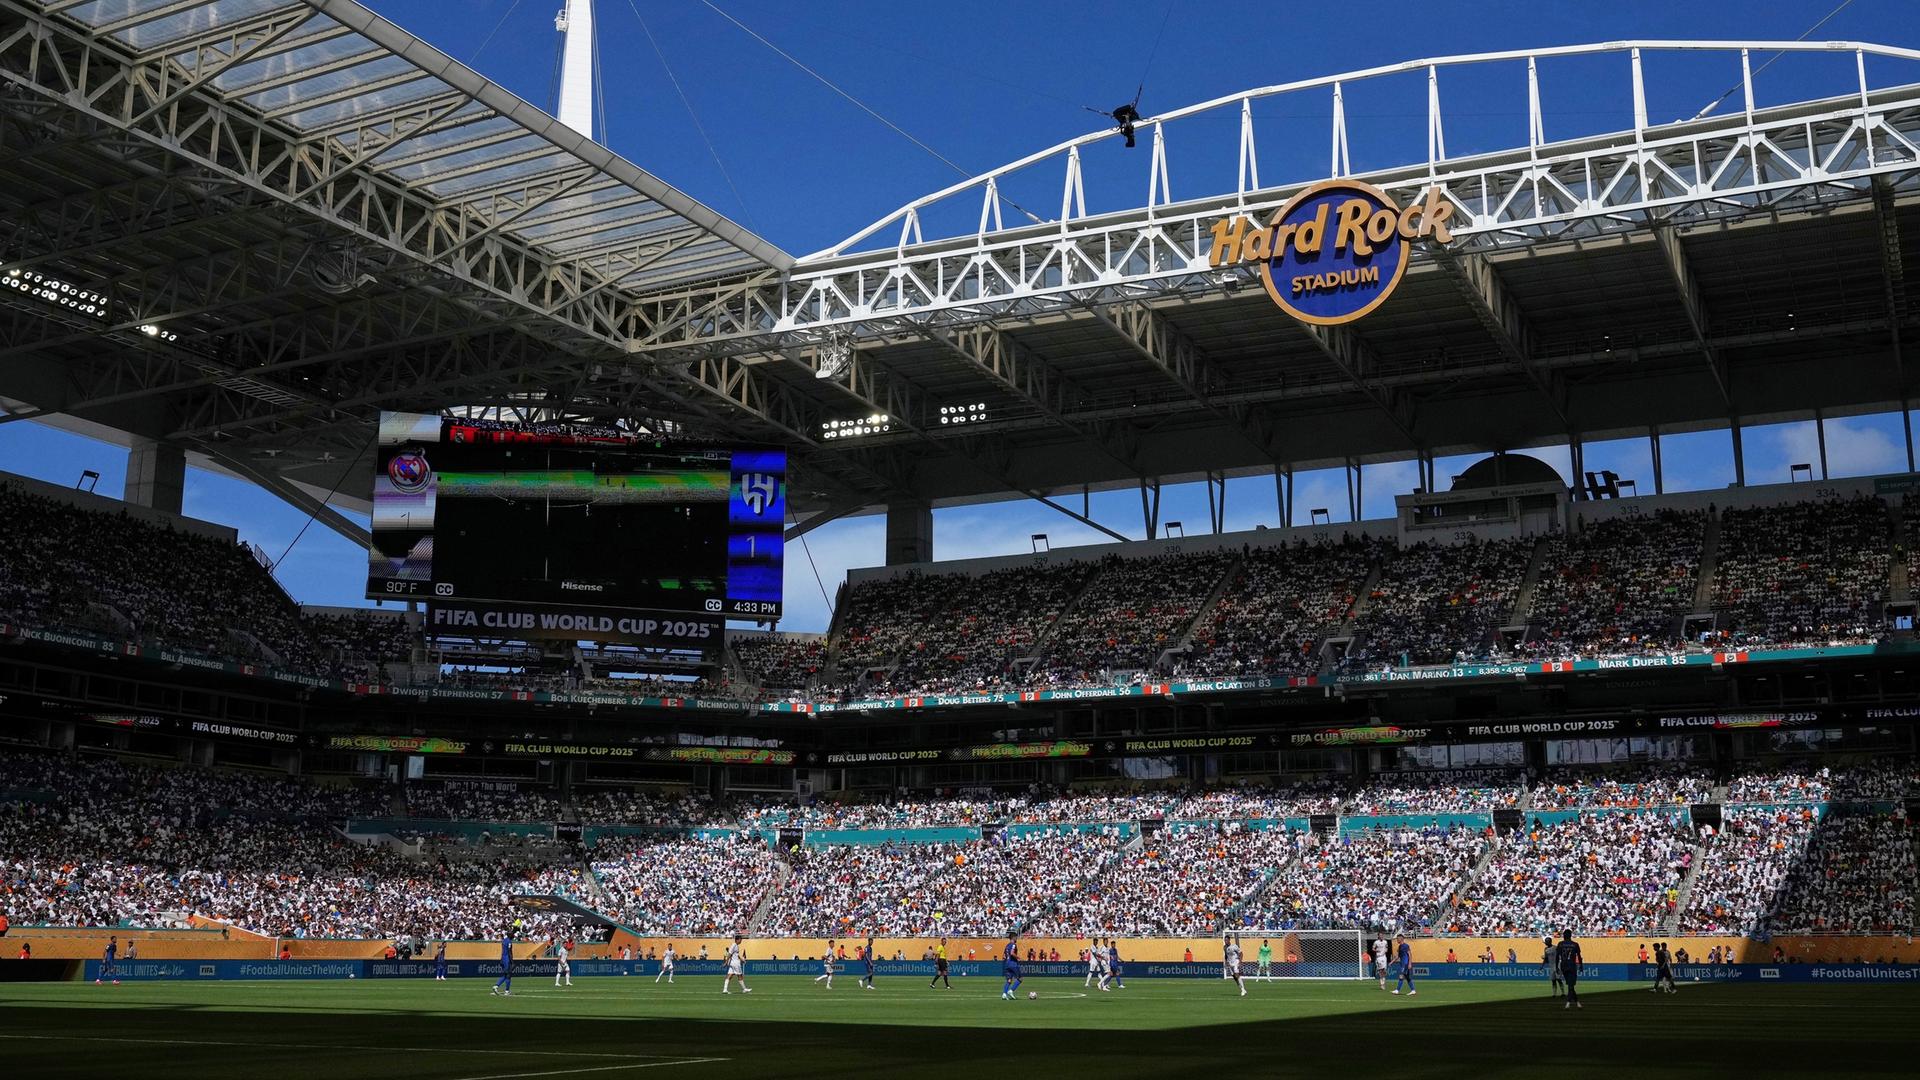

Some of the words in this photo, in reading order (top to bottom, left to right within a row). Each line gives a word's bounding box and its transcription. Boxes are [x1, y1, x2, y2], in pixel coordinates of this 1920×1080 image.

[1209, 203, 1330, 267] Hard
[1334, 186, 1455, 256] Rock
[1292, 266, 1379, 292] STADIUM
[1815, 489, 1835, 498] 334
[1620, 506, 1640, 515] 333
[1313, 532, 1329, 541] 331
[1454, 532, 1473, 541] 332
[746, 535, 757, 559] 1
[410, 582, 417, 594] F
[437, 584, 454, 595] CC
[560, 581, 603, 592] Hisense
[705, 600, 722, 612] CC
[734, 601, 757, 613] 4:33
[760, 602, 776, 614] PM
[434, 609, 478, 626] FIFA
[483, 611, 535, 630] CLUB
[540, 613, 613, 633] WORLD
[617, 617, 657, 635] CUP
[102, 641, 114, 651] 85
[161, 651, 176, 663] BILL
[1598, 659, 1629, 669] MARK
[1632, 657, 1667, 668] DUPER
[1671, 656, 1686, 665] 85
[1390, 671, 1409, 681] DAN
[1412, 670, 1450, 680] MARINO
[1452, 668, 1464, 677] 13
[319, 678, 329, 688] 66
[1187, 682, 1213, 692] MARK
[1215, 680, 1256, 691] CLAYTON
[1258, 679, 1271, 688] 83
[392, 686, 429, 697] DWIGHT
[432, 688, 488, 699] STEPHENSON
[490, 691, 503, 699] 57
[1050, 690, 1072, 699] JOHN
[1074, 689, 1117, 699] OFFERDAHL
[1119, 687, 1131, 696] 56
[551, 694, 569, 703] BOB
[631, 697, 644, 705] 67
[697, 700, 739, 710] RICHMOND
[768, 703, 779, 711] 78
[938, 696, 960, 706] DOUG
[962, 696, 991, 705] BETTERS
[993, 694, 1004, 703] 75
[819, 704, 834, 712] BOB
[884, 700, 896, 708] 73
[1866, 708, 1893, 718] FIFA
[1660, 717, 1685, 727] FIFA
[1687, 716, 1716, 726] CLUB
[1717, 714, 1761, 724] WORLD
[1762, 713, 1785, 722] CUP
[192, 721, 209, 732] FIFA
[210, 724, 230, 735] CLUB
[232, 727, 259, 738] WORLD
[260, 730, 275, 741] CUP
[1469, 726, 1491, 735] FIFA
[1493, 724, 1520, 734] CLUB
[1522, 722, 1562, 732] WORLD
[1563, 721, 1585, 731] CUP
[1291, 734, 1312, 743] FIFA
[1314, 732, 1339, 742] CLUB
[1341, 730, 1378, 741] WORLD
[1380, 730, 1399, 739] CUP
[505, 744, 525, 753] FIFA
[527, 744, 551, 754] CLUB
[553, 745, 587, 755] WORLD
[589, 747, 608, 755] CUP
[1126, 741, 1146, 750] FIFA
[1147, 740, 1170, 749] CLUB
[1172, 738, 1206, 748] WORLD
[1208, 737, 1227, 747] CUP
[828, 754, 845, 763] FIFA
[846, 753, 867, 762] CLUB
[869, 752, 898, 761] WORLD
[899, 752, 916, 760] CUP
[134, 965, 158, 976] UNITES
[240, 964, 353, 975] #FootballUnitesTheWorld
[373, 965, 398, 975] FOOTBALL
[1047, 965, 1068, 974] UNITES
[1684, 967, 1711, 977] UNITES
